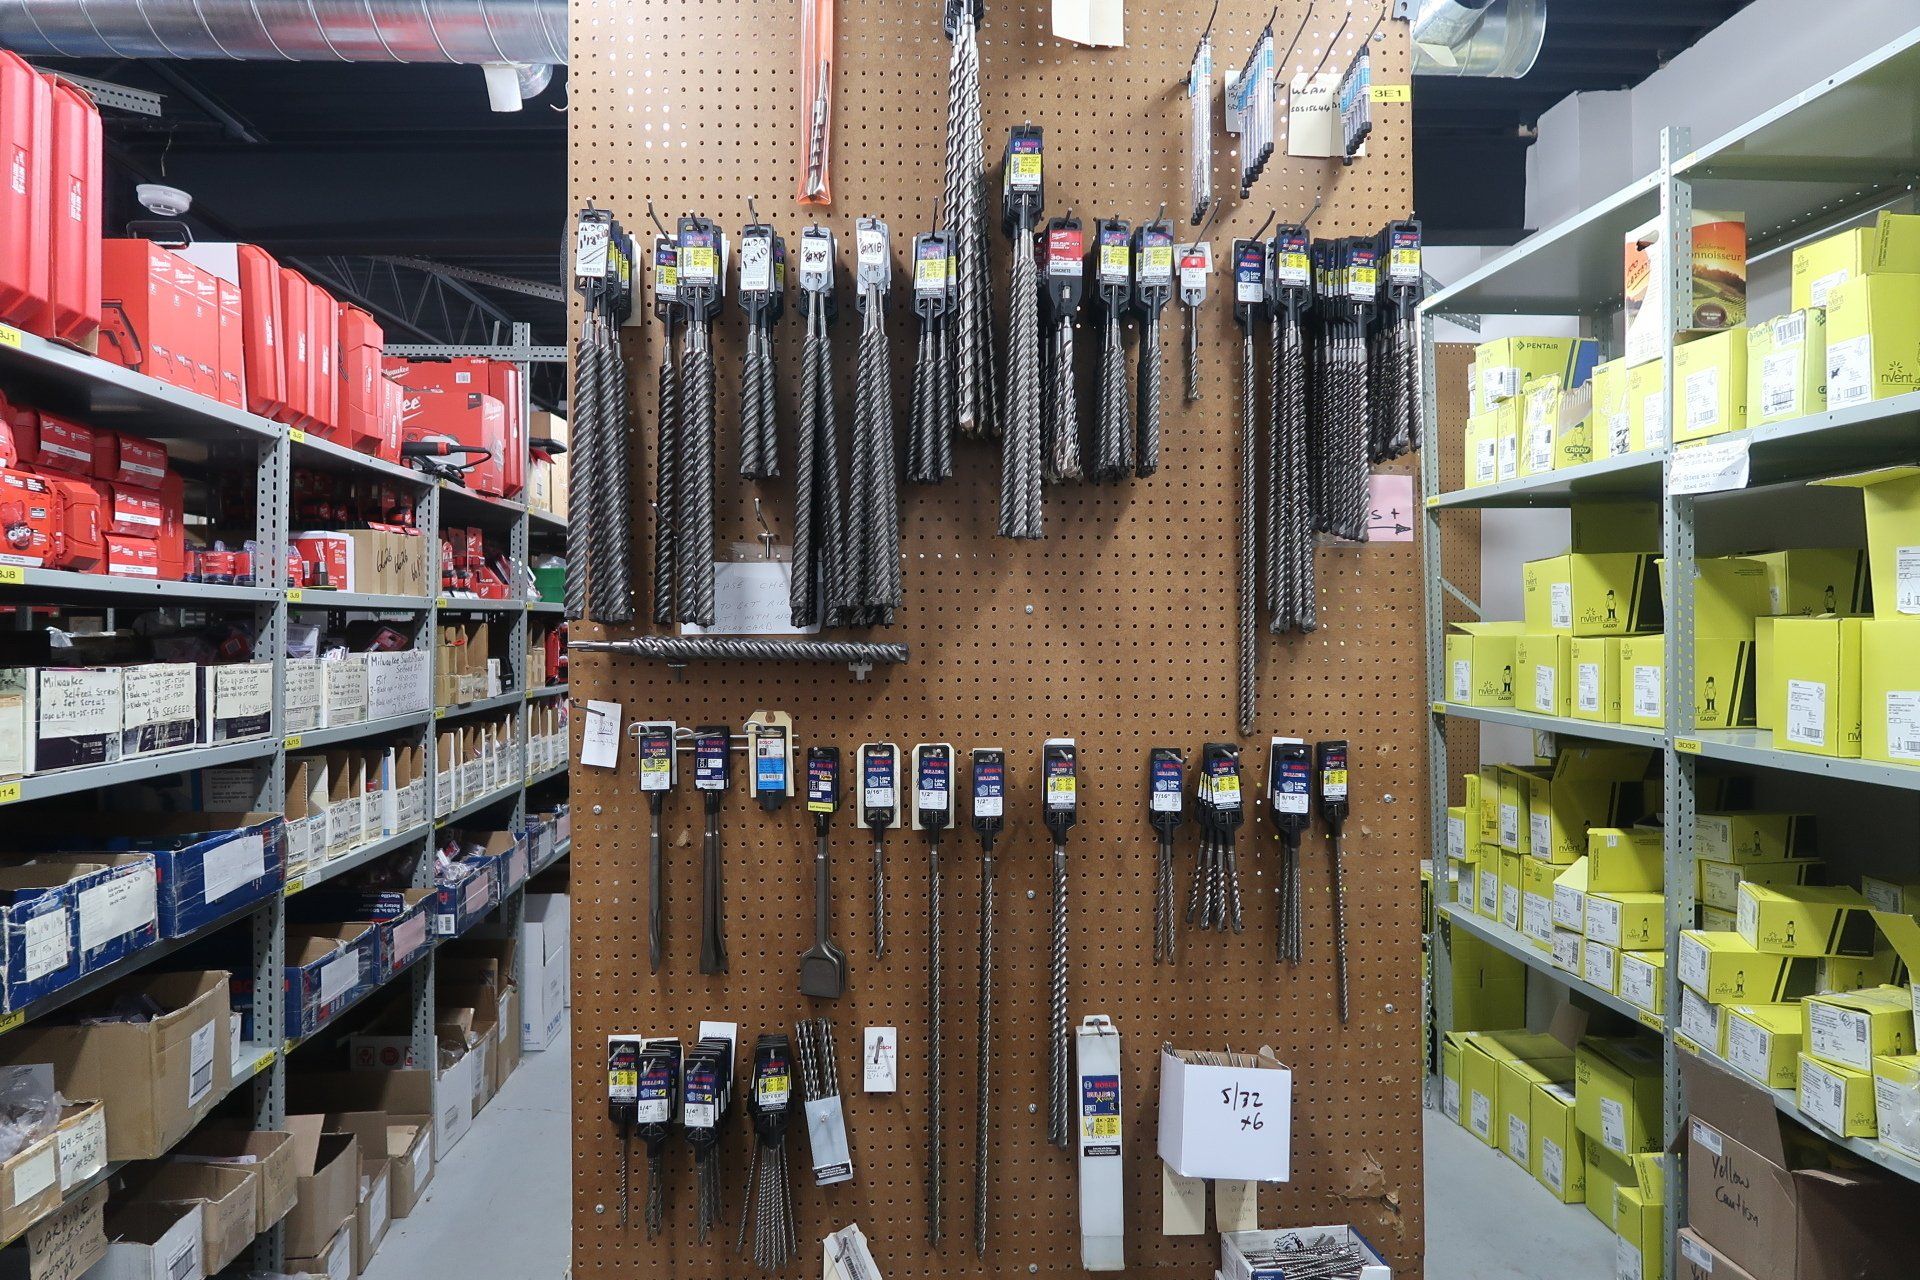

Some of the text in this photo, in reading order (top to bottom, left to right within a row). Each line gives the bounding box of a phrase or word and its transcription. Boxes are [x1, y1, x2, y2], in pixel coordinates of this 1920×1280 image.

[1691, 252, 1742, 261] onnoisseur
[1527, 342, 1559, 351] PENTAIR
[1565, 446, 1591, 454] CADDY
[1580, 614, 1605, 625] nVent
[44, 675, 84, 688] Milwaukee
[1478, 687, 1500, 696] nVent
[162, 704, 190, 718] SELFEED
[1677, 742, 1696, 750] 3D32
[1559, 844, 1581, 853] nVent
[0, 1015, 18, 1028] J21
[1677, 1036, 1696, 1051] 3D34
[1711, 1155, 1750, 1190] Yellow
[1715, 1185, 1760, 1227] Caution
